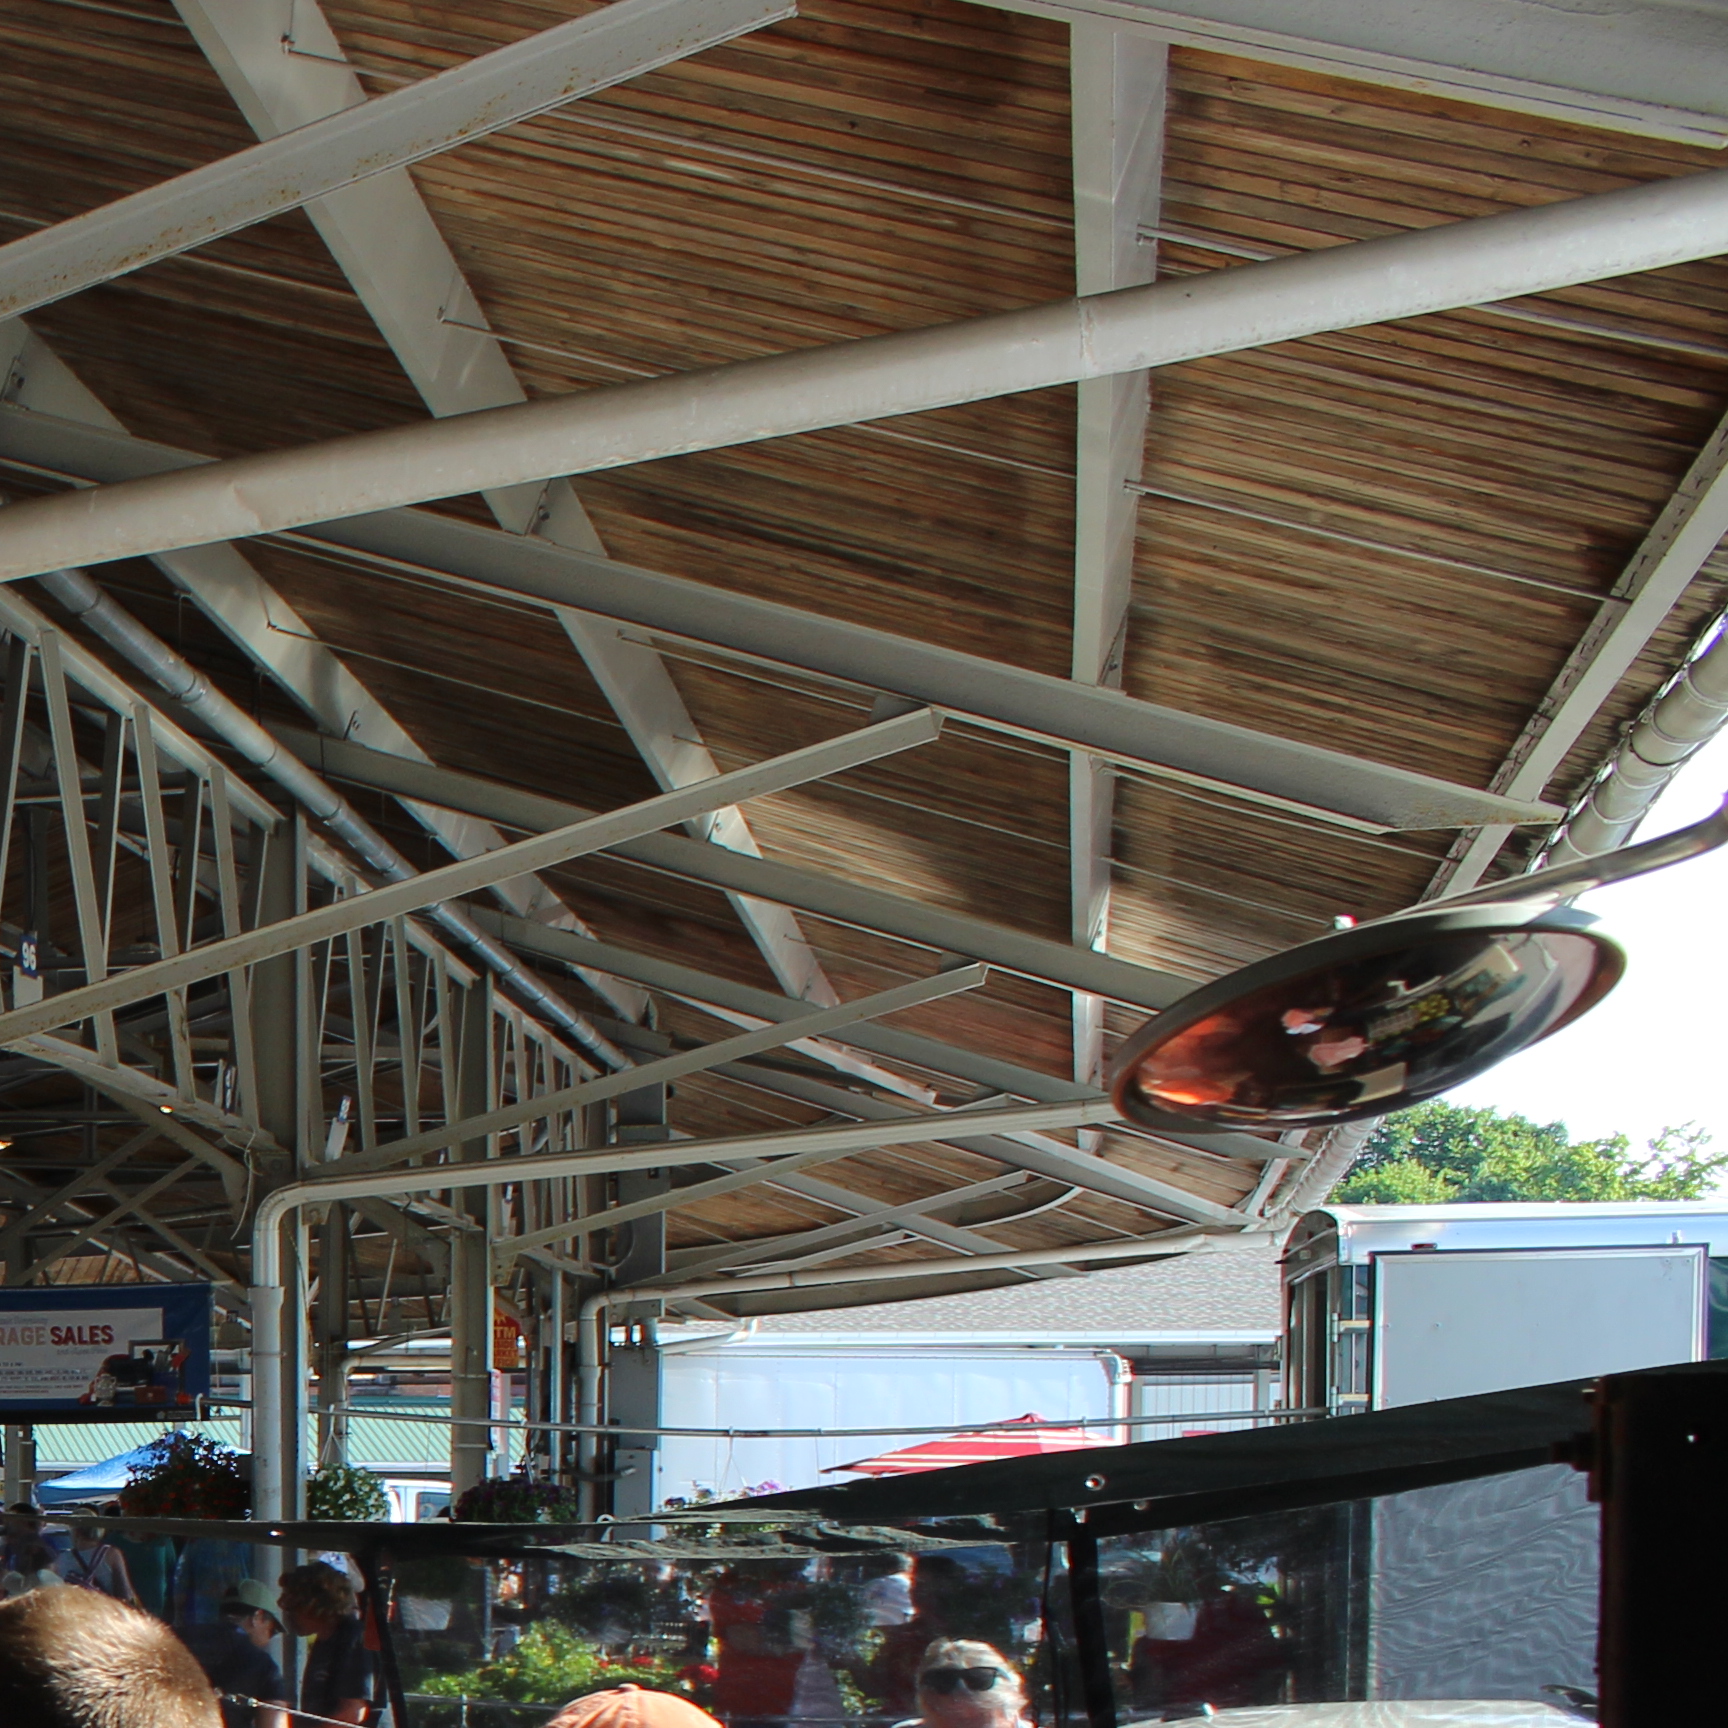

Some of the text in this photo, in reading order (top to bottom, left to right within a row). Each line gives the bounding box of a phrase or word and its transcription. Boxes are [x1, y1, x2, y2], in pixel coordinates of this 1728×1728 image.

[22, 942, 37, 971] 96
[50, 1324, 115, 1345] SALES
[494, 1326, 517, 1339] TM
